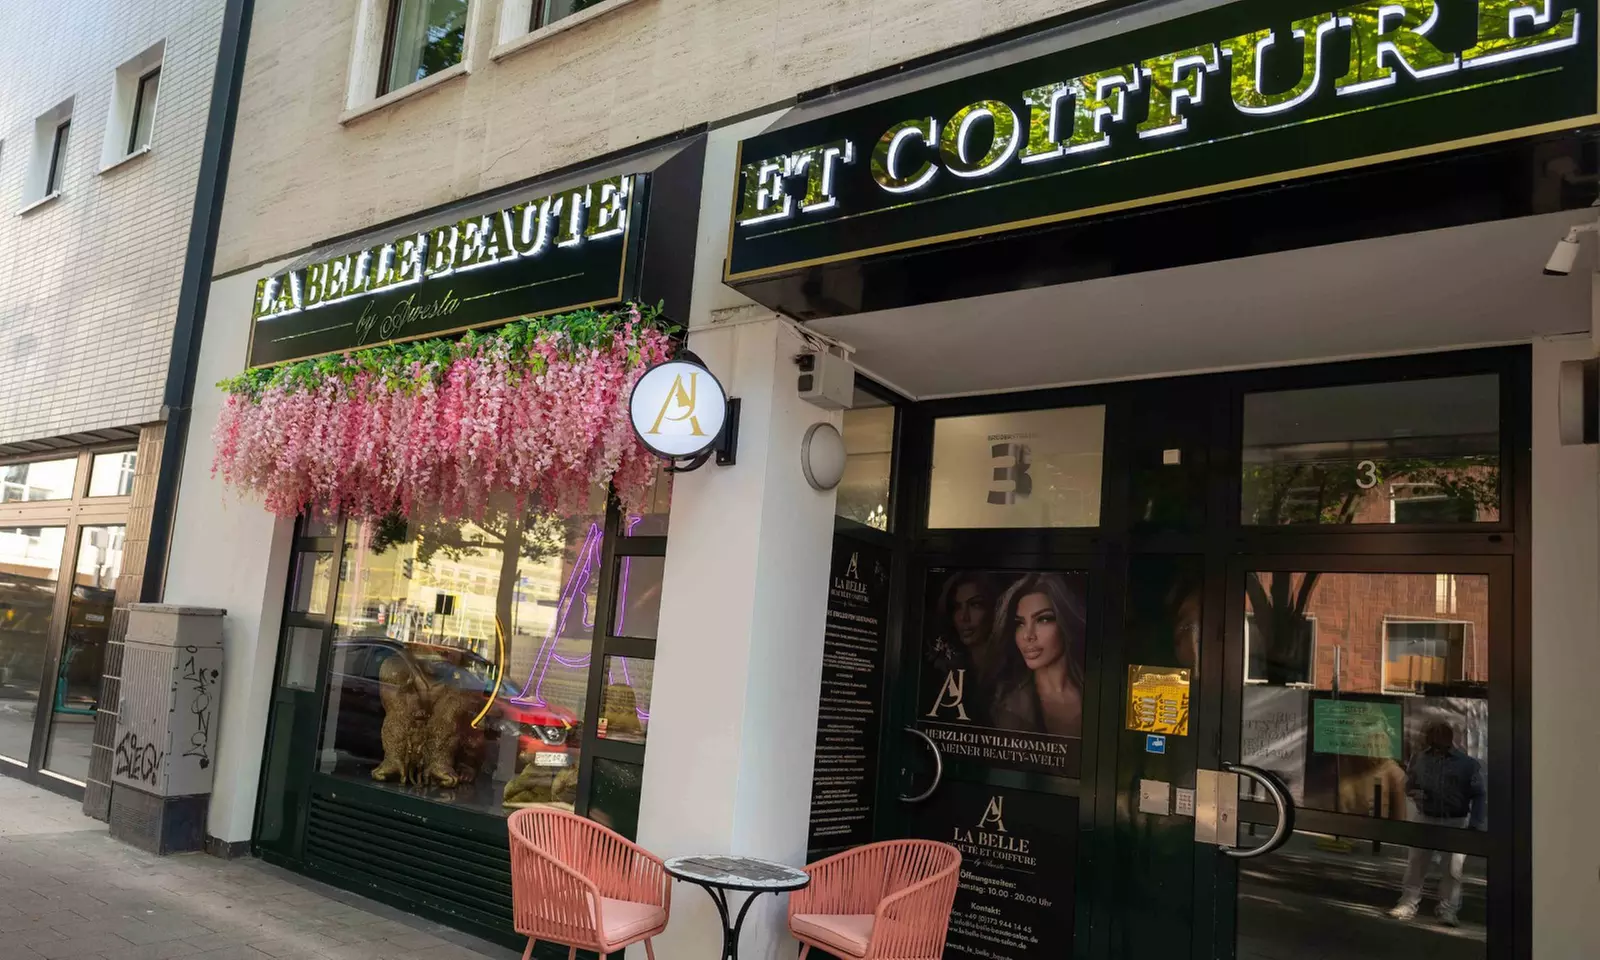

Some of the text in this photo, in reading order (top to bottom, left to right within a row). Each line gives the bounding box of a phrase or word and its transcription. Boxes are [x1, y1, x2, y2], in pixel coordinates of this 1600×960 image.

[736, 0, 1580, 226] ET COIFFURE
[253, 268, 306, 321] LA
[303, 230, 432, 310] BELLE
[355, 288, 460, 346] by Awesta
[1356, 460, 1377, 489] 3
[925, 728, 1068, 755] HERZLICH WILLKOMMEN
[939, 742, 981, 757] MEINER
[982, 749, 1066, 768] BEAUTY-WELT!
[953, 827, 1030, 854] LA BELLE
[979, 845, 991, 857] ET
[992, 849, 1037, 866] COIFFURE
[960, 868, 1017, 889] Öffnungszeiten:
[970, 901, 1002, 915] Kontakt:
[987, 886, 1009, 899] 10.00
[1014, 892, 1038, 904] 20.00
[1038, 897, 1053, 907] Uhr
